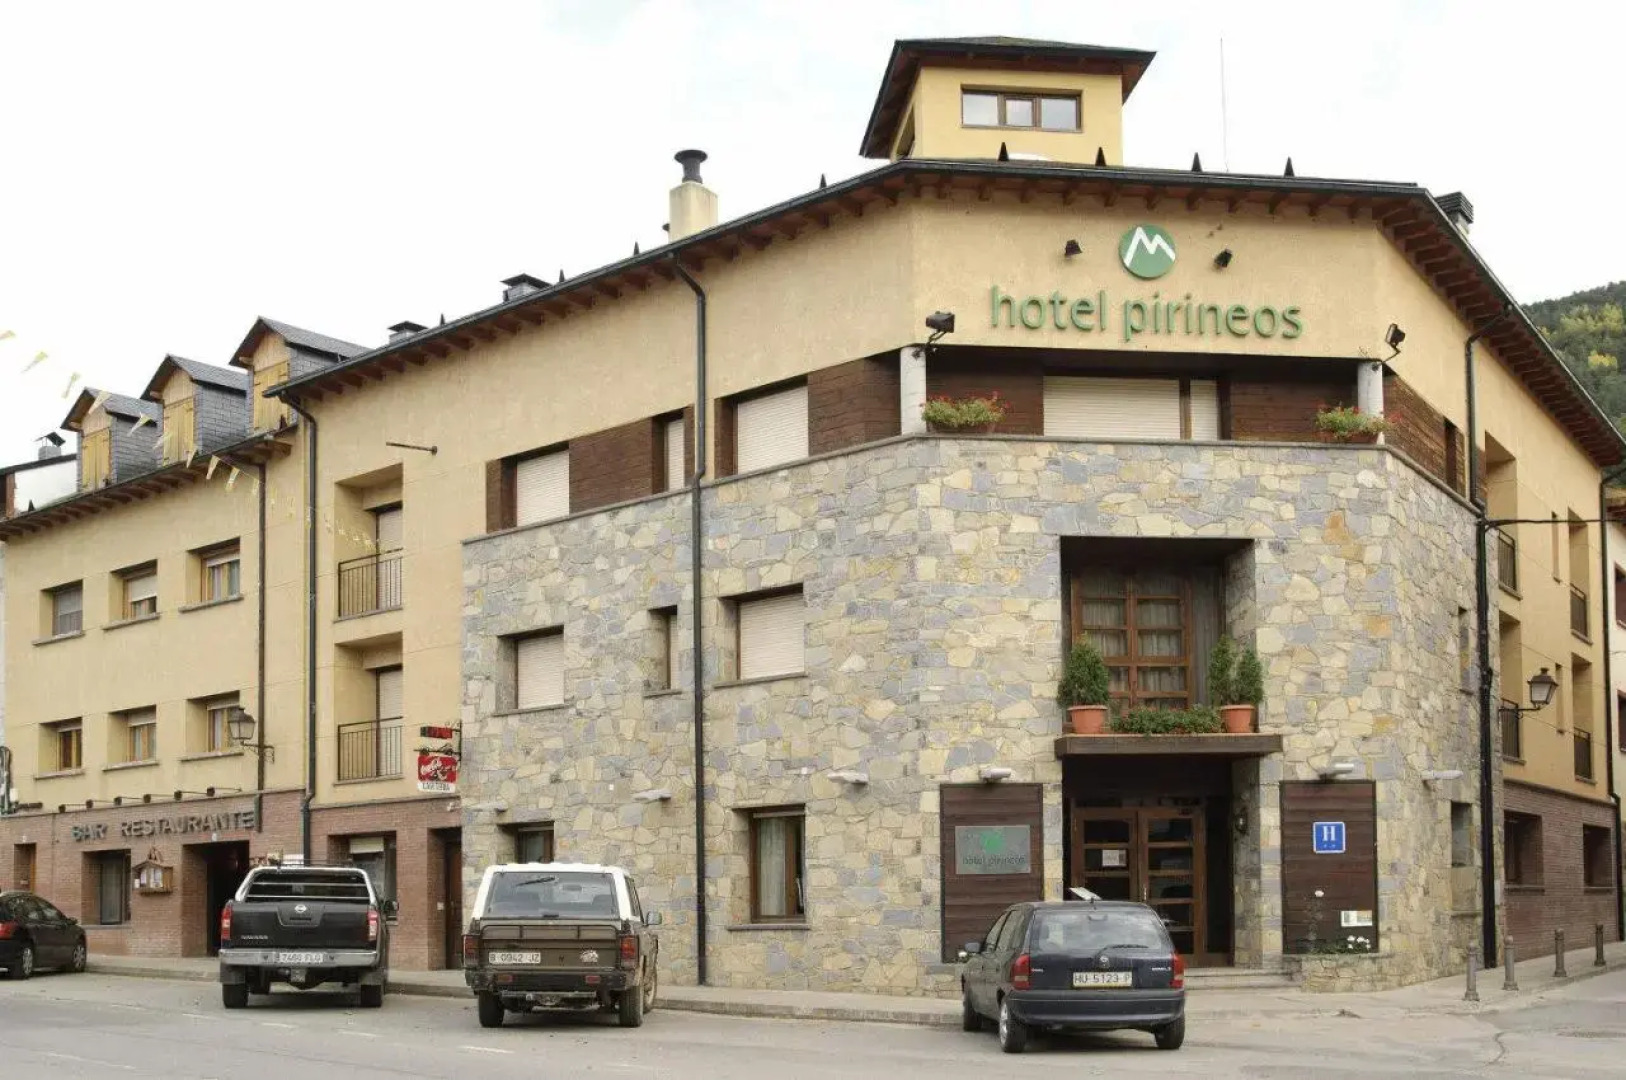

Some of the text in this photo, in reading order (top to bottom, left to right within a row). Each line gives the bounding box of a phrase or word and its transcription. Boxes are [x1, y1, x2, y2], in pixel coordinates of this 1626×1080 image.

[991, 285, 1304, 342] hotel pirineos
[72, 811, 256, 842] BAR RESTAURANTE
[1321, 825, 1337, 842] H
